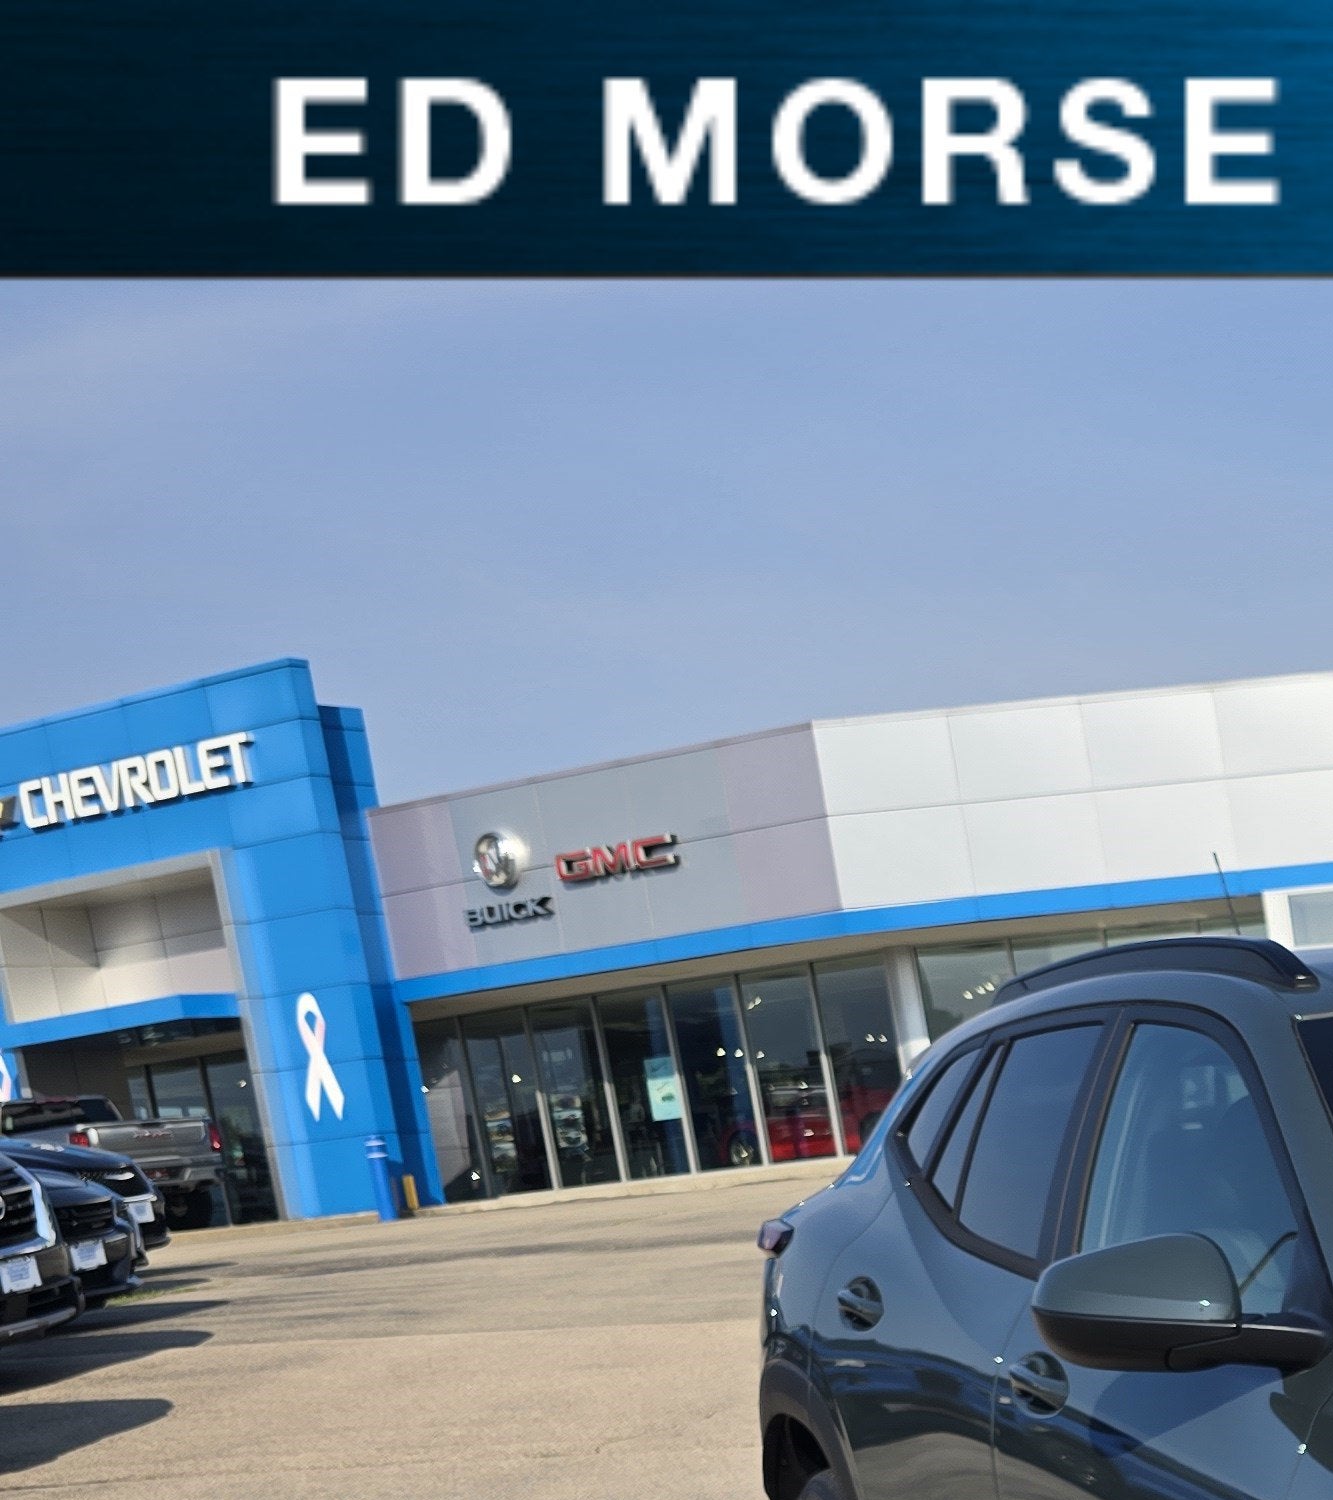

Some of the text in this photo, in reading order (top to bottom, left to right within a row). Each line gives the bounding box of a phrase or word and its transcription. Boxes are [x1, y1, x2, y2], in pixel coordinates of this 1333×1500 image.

[19, 731, 250, 829] CHEVROLET
[554, 832, 676, 882] GMC
[464, 897, 553, 928] BUICK
